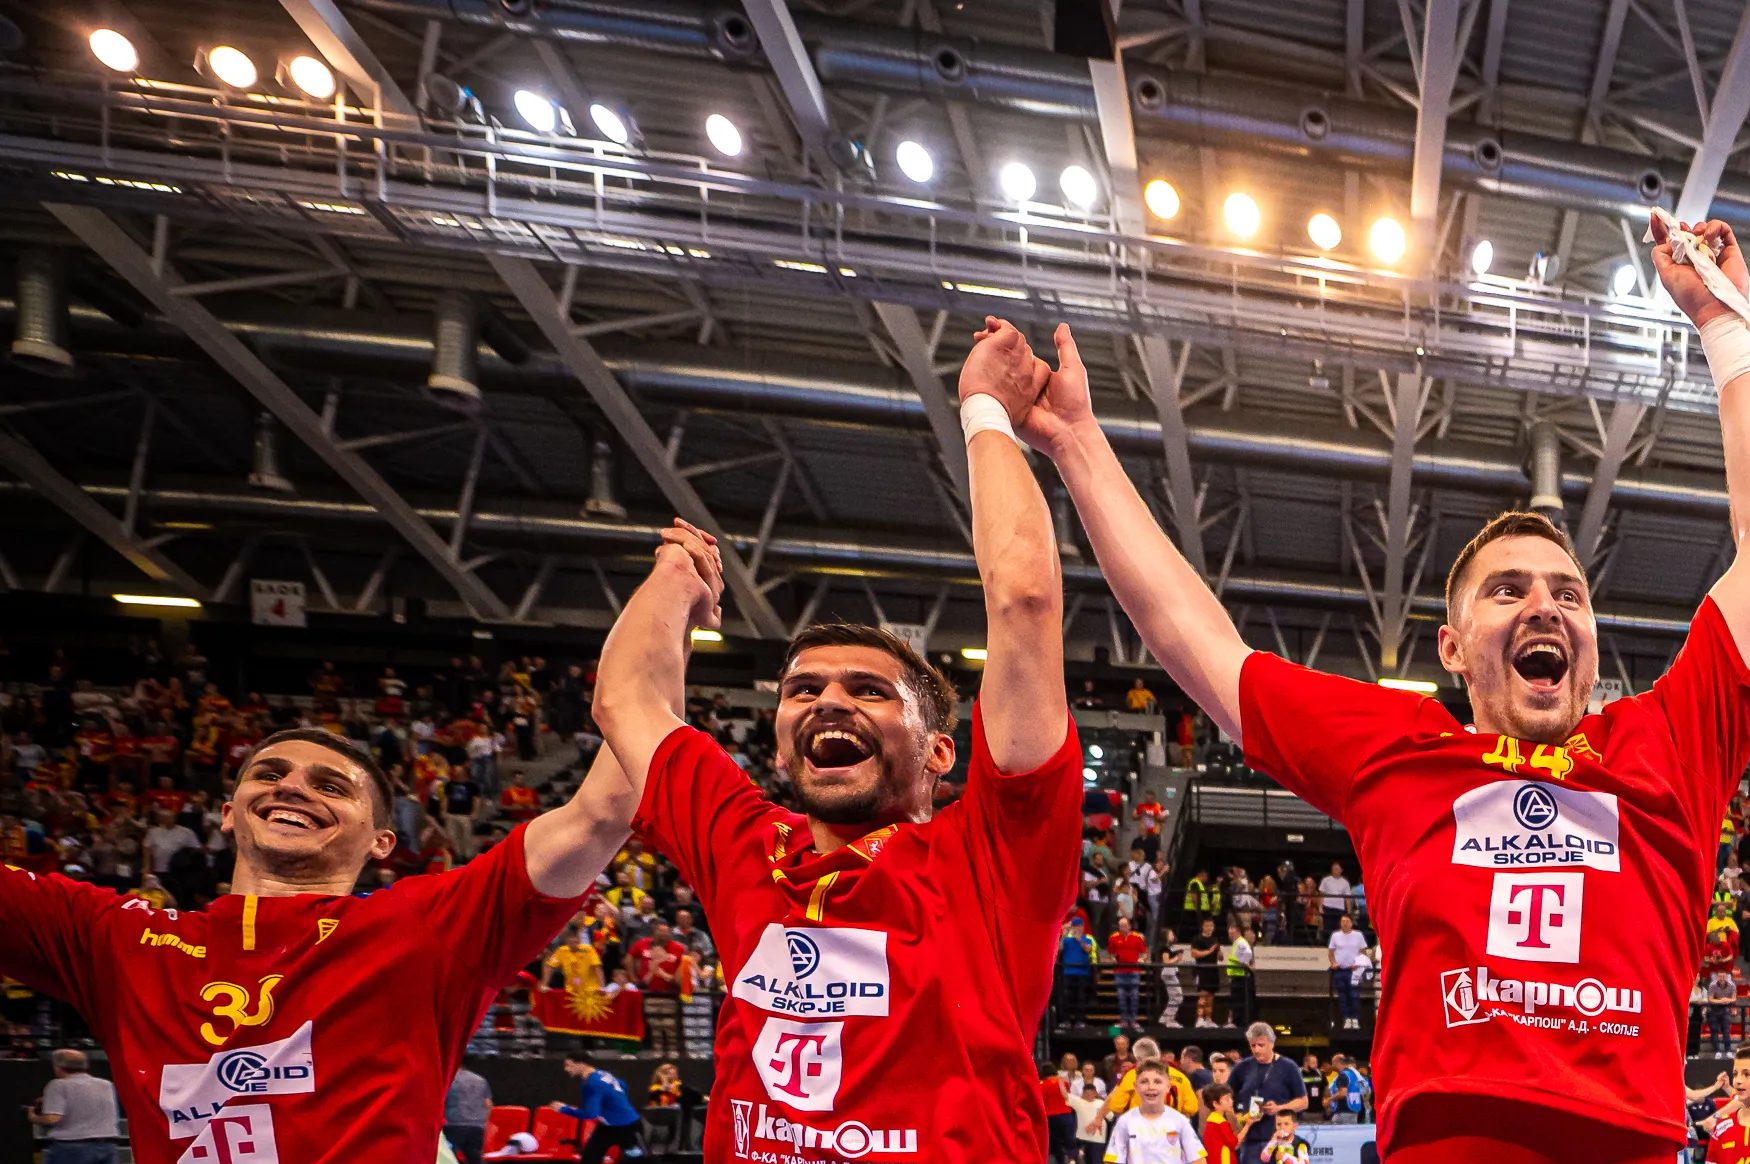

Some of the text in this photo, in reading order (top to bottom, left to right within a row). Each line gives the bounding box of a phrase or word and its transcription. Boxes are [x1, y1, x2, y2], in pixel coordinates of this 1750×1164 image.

[1482, 734, 1574, 781] 44
[1460, 833, 1615, 855] ALKALOID
[1493, 851, 1584, 865] SKOPJE
[1508, 884, 1566, 949] T
[742, 974, 884, 1000] ALKLOID
[771, 1032, 828, 1098] T
